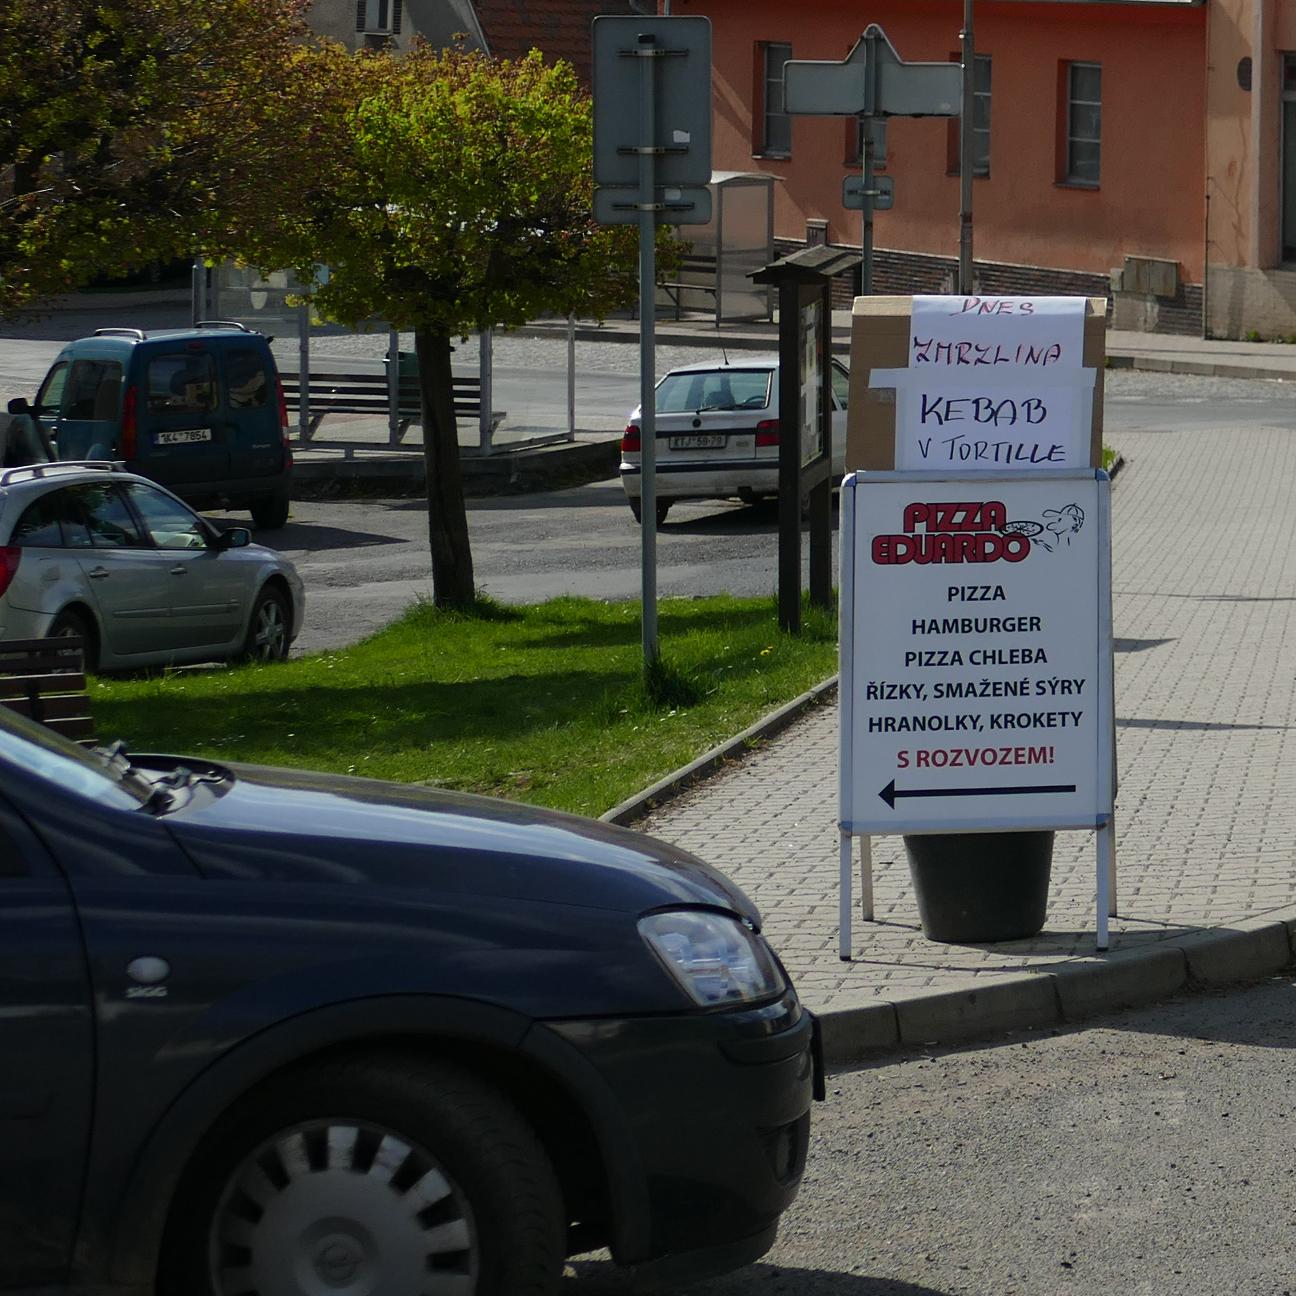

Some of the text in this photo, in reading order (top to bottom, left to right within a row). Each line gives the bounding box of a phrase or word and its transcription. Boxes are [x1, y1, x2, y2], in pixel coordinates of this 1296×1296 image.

[951, 297, 1034, 316] DNES
[912, 336, 1061, 366] ZMRZLINA
[920, 394, 1047, 426] KEBAB
[942, 434, 1066, 464] TORTILLE
[903, 501, 1007, 533] PIZZA
[871, 533, 1031, 565] EDUARDO
[947, 585, 1006, 602] PIZZA
[911, 616, 1042, 635] HAMBURGER
[904, 648, 1048, 667] PIZZA CHLEBA
[866, 676, 1086, 701] ŘÍZKY, SMAŽENÉ SÝRY
[868, 711, 1083, 733] HRANOLKY, KROKETY
[896, 746, 1055, 768] S ROZVOZEM!
